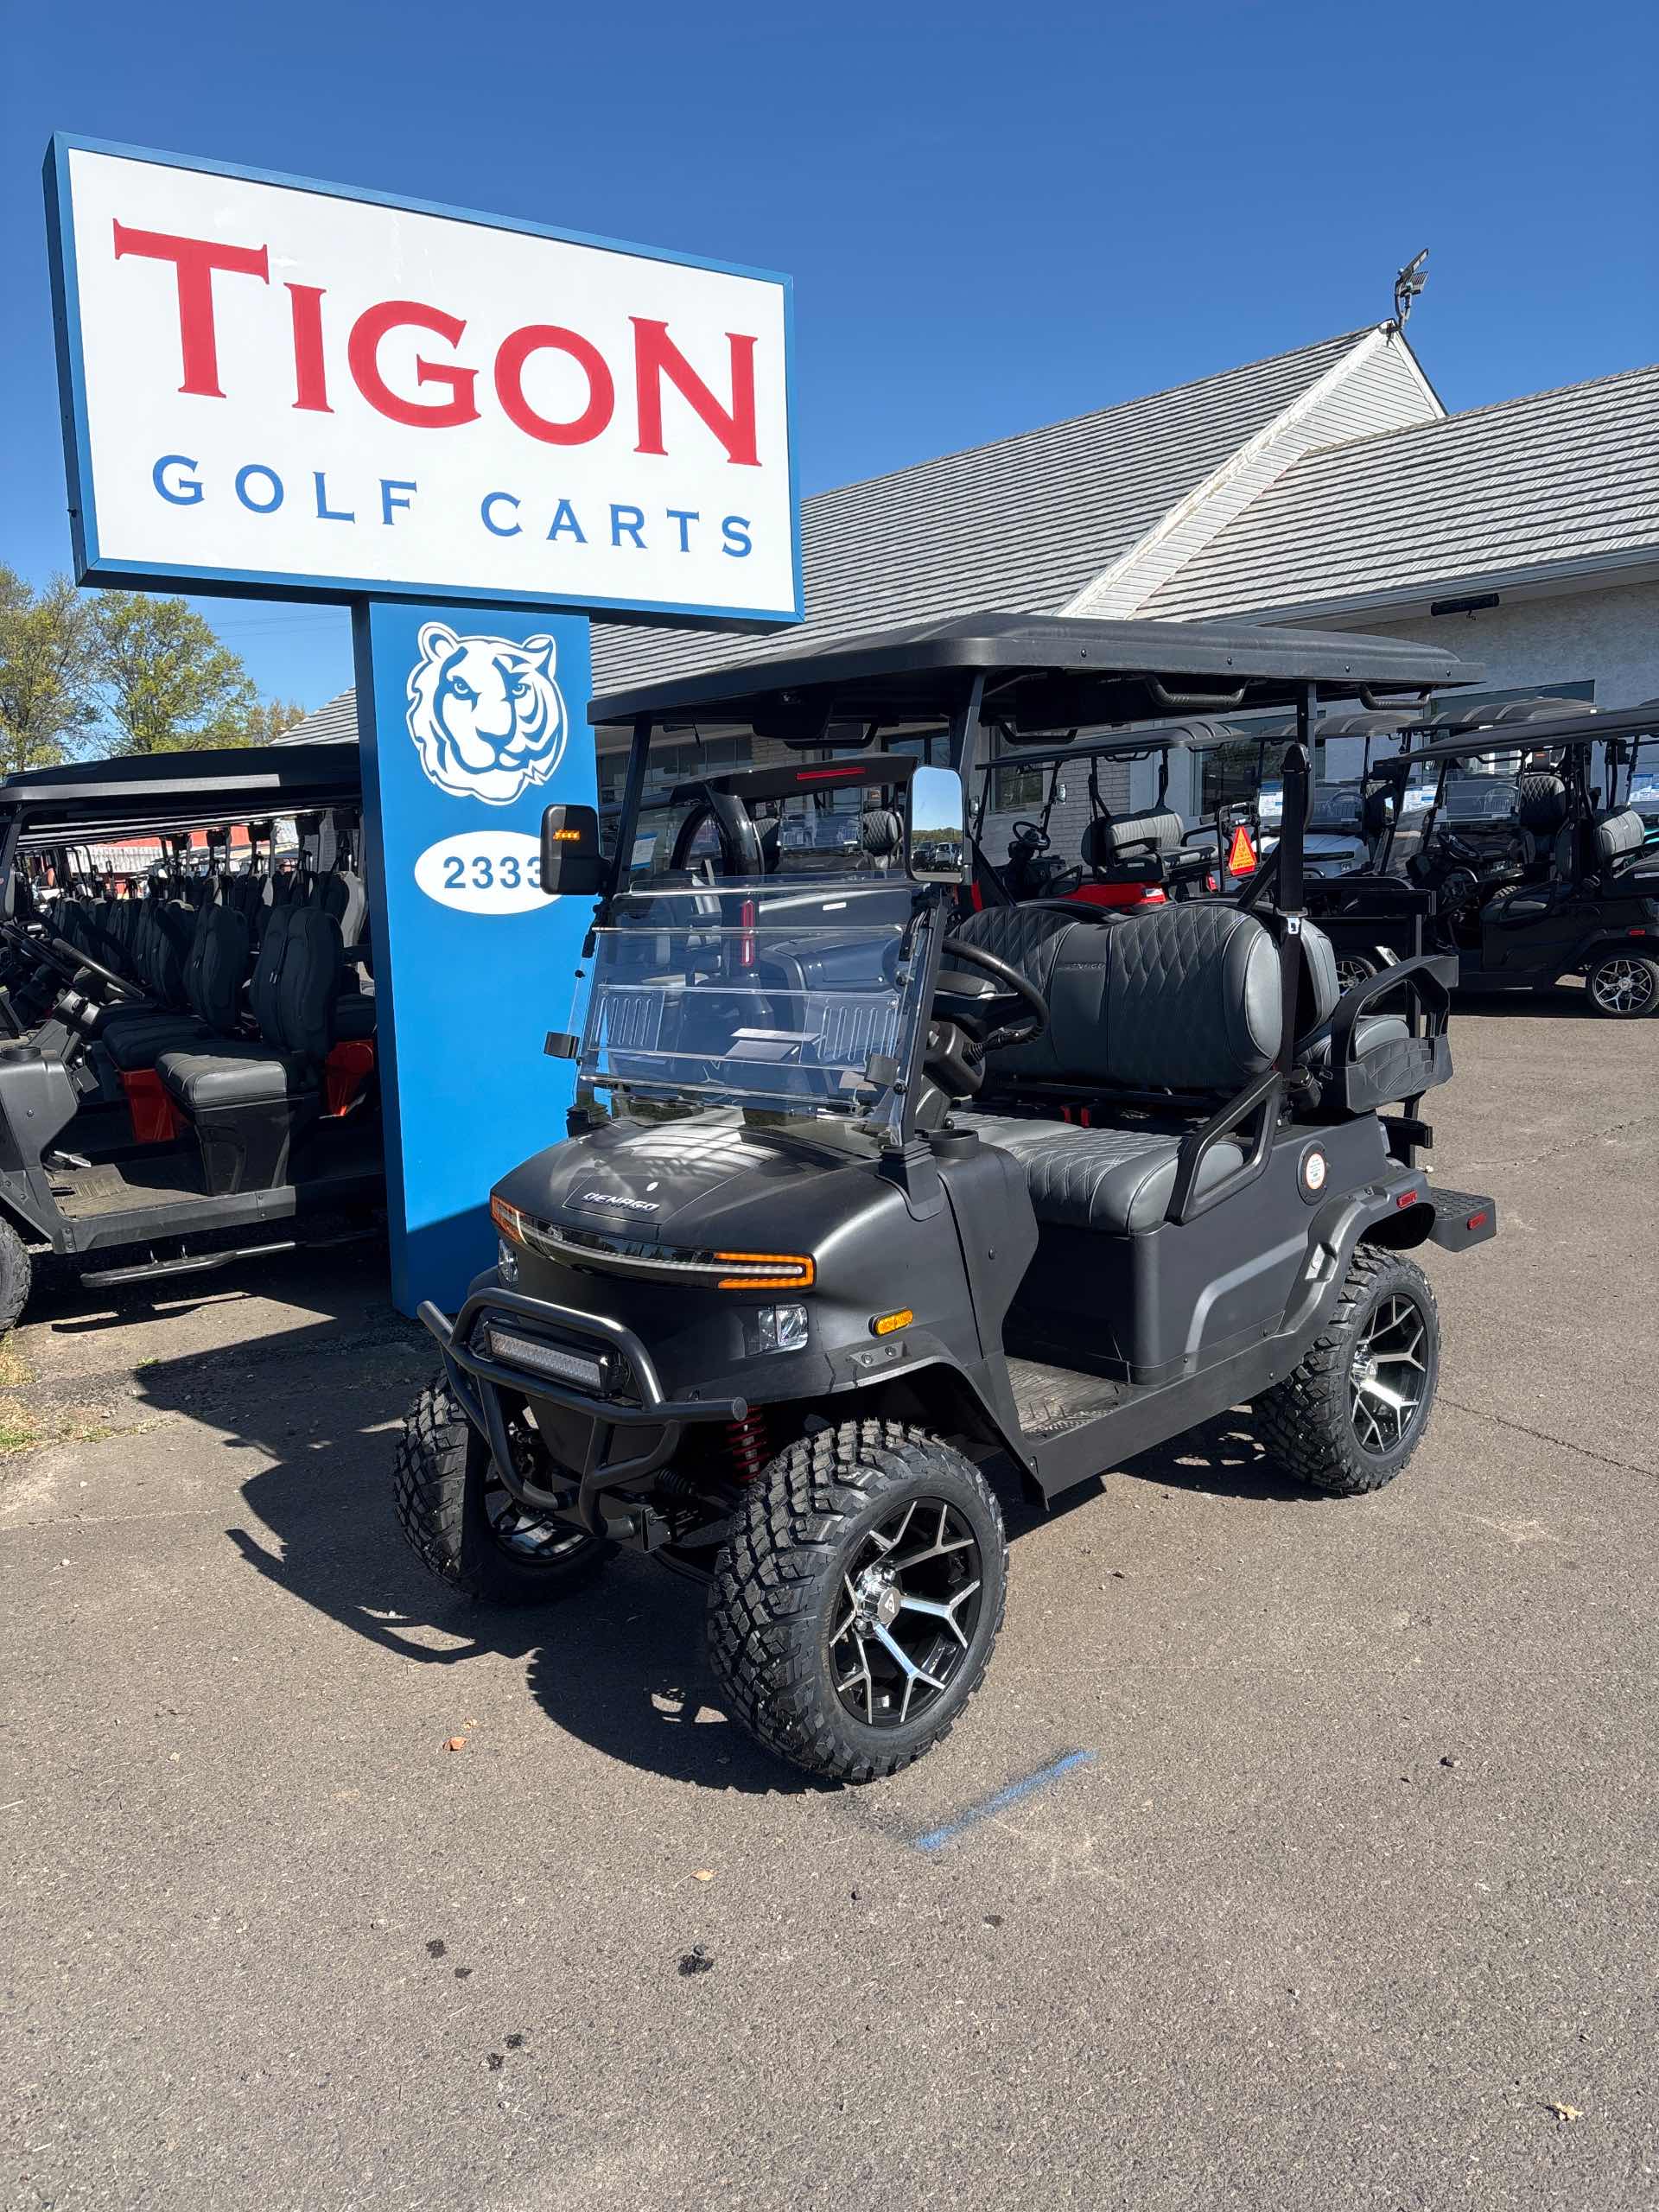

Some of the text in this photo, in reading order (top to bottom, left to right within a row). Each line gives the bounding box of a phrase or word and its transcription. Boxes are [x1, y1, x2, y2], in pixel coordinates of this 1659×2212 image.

[112, 218, 761, 467] TIGON
[152, 454, 753, 557] GOLF CARTS
